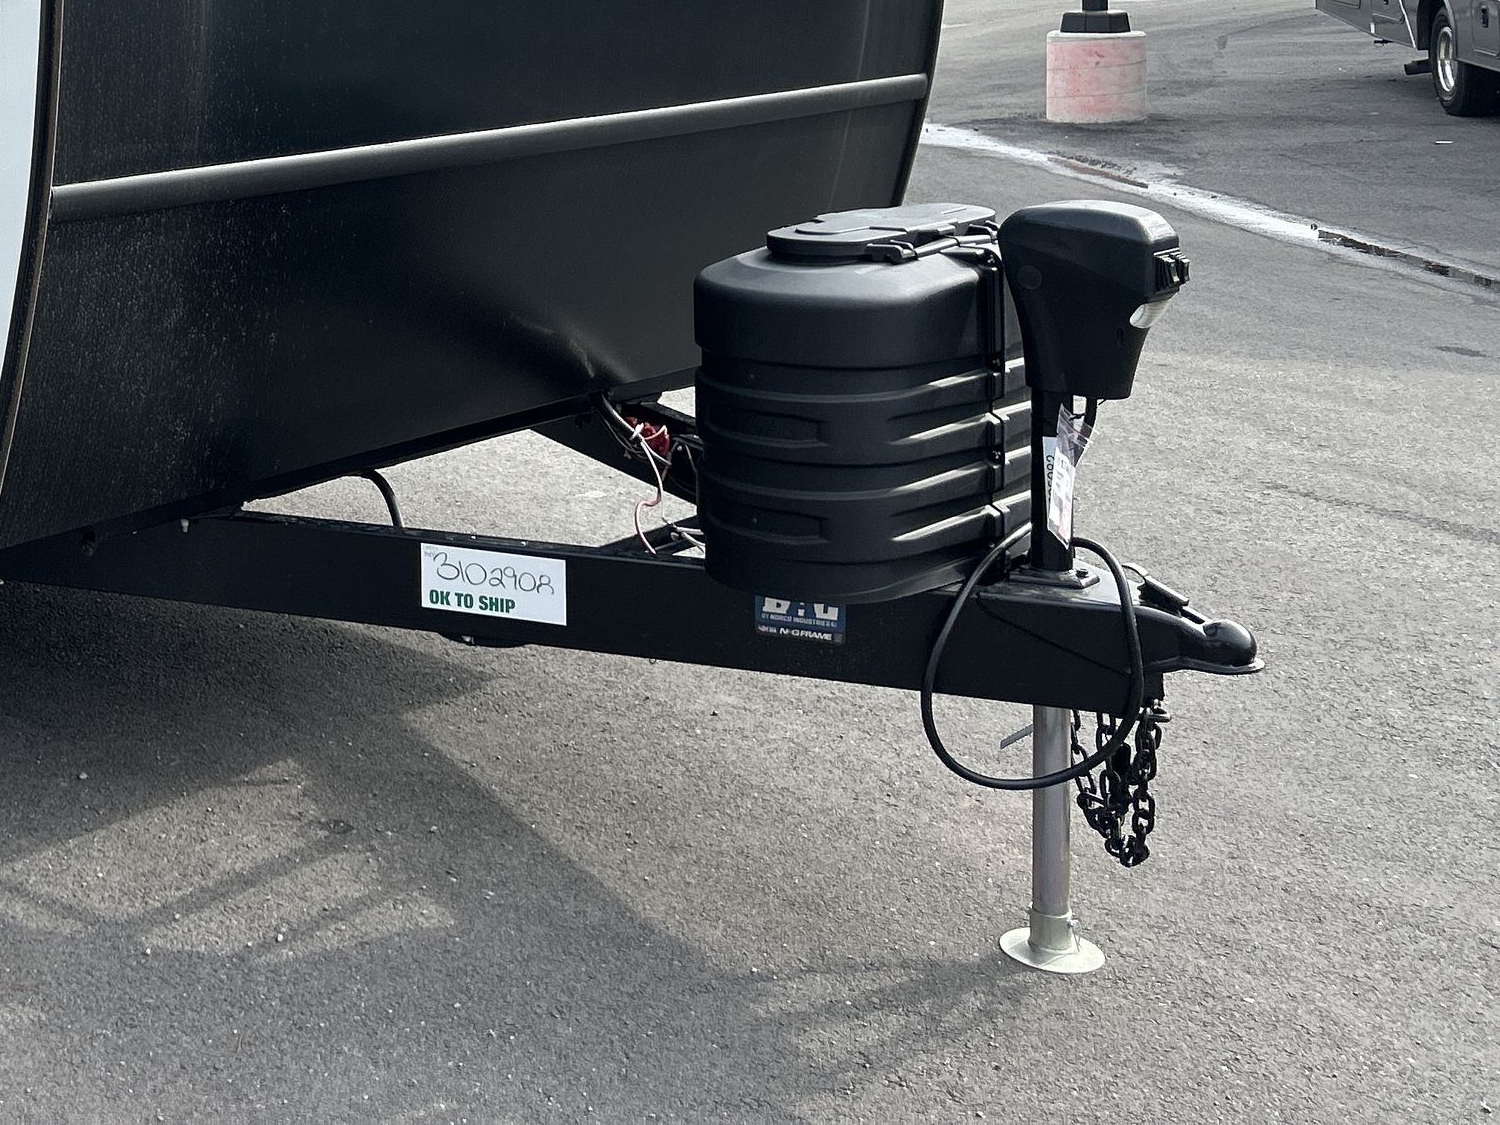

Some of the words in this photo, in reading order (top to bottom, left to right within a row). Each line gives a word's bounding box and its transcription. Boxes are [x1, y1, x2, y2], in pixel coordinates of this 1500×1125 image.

[429, 589, 451, 606] OK
[454, 592, 474, 609] TO
[478, 595, 516, 614] SHIP
[800, 631, 832, 641] FRAME
